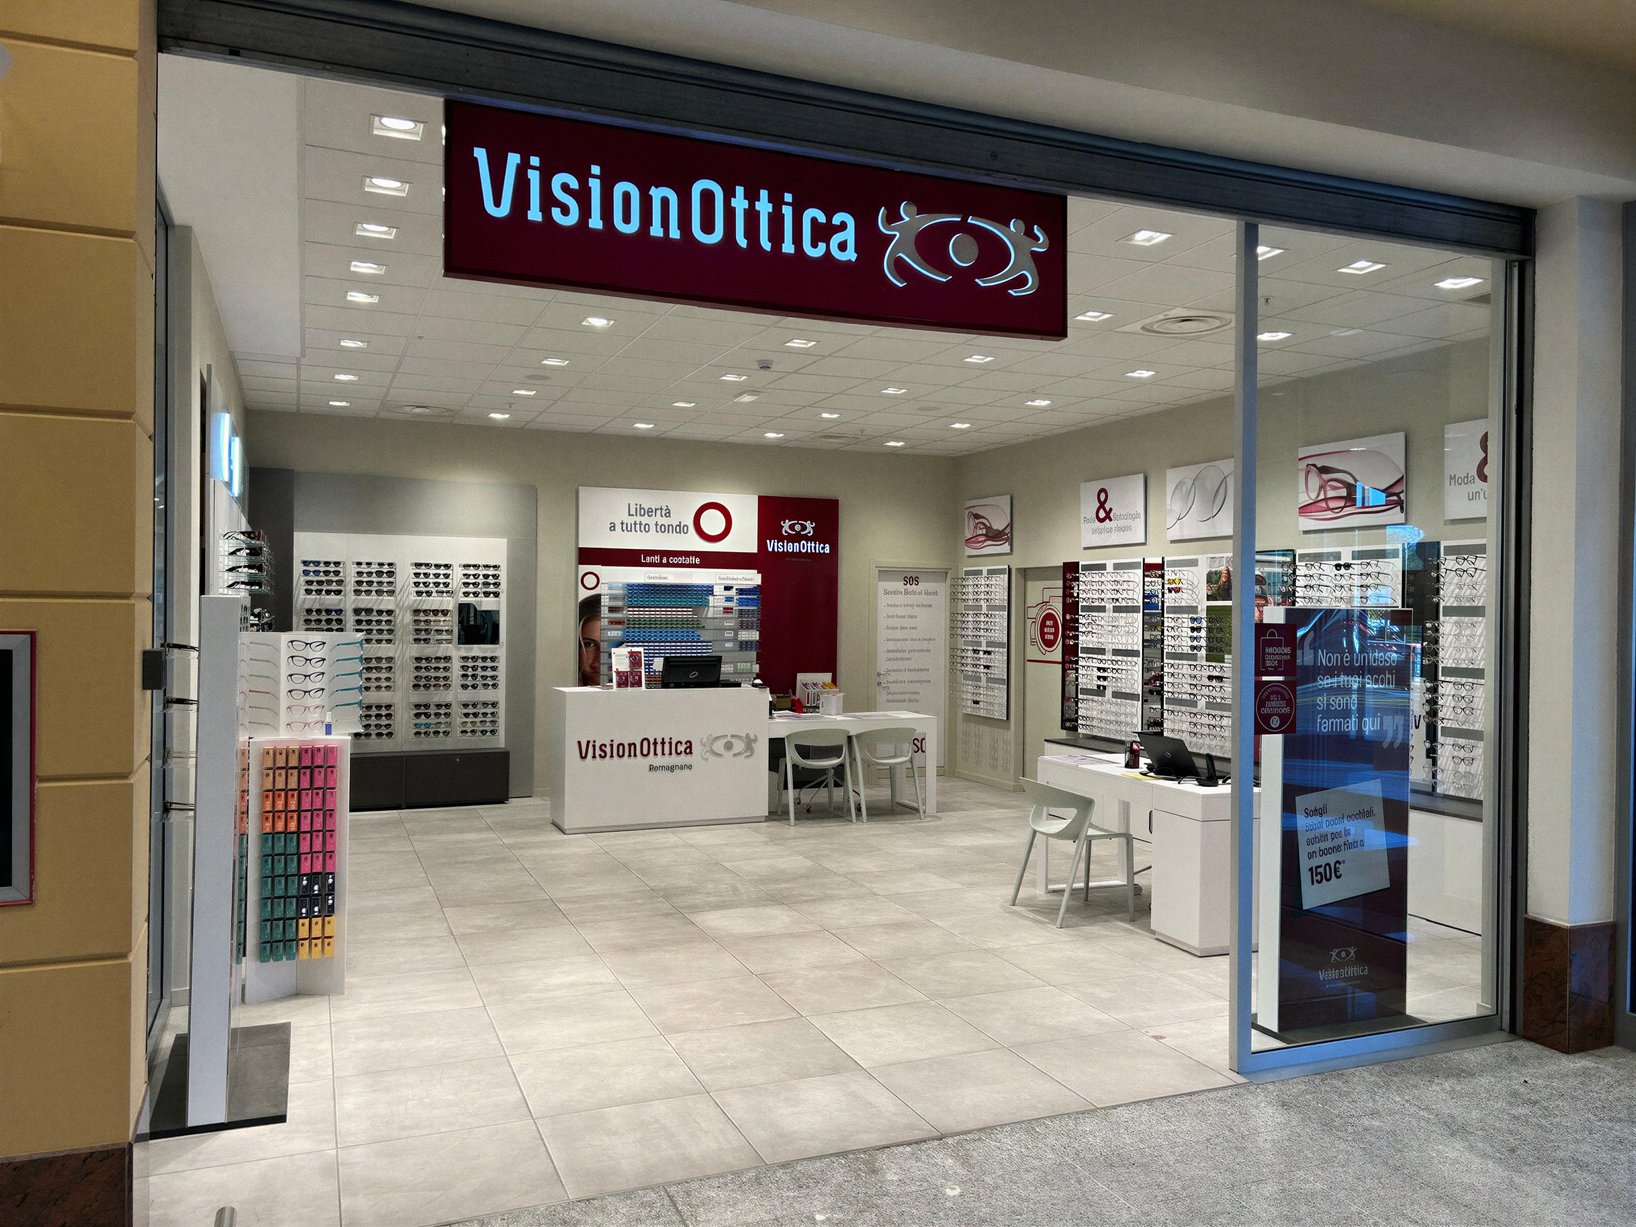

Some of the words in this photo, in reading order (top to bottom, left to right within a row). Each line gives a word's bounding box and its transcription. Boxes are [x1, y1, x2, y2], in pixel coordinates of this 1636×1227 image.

[473, 146, 858, 263] VisionOttica
[1449, 472, 1476, 487] Moda
[627, 502, 672, 519] Libertà
[608, 521, 617, 532] a
[620, 520, 651, 533] tutto
[654, 521, 690, 535] tondo
[766, 539, 831, 554] VisionOttica
[902, 575, 920, 587] SOS
[577, 737, 693, 760] VisionOttica
